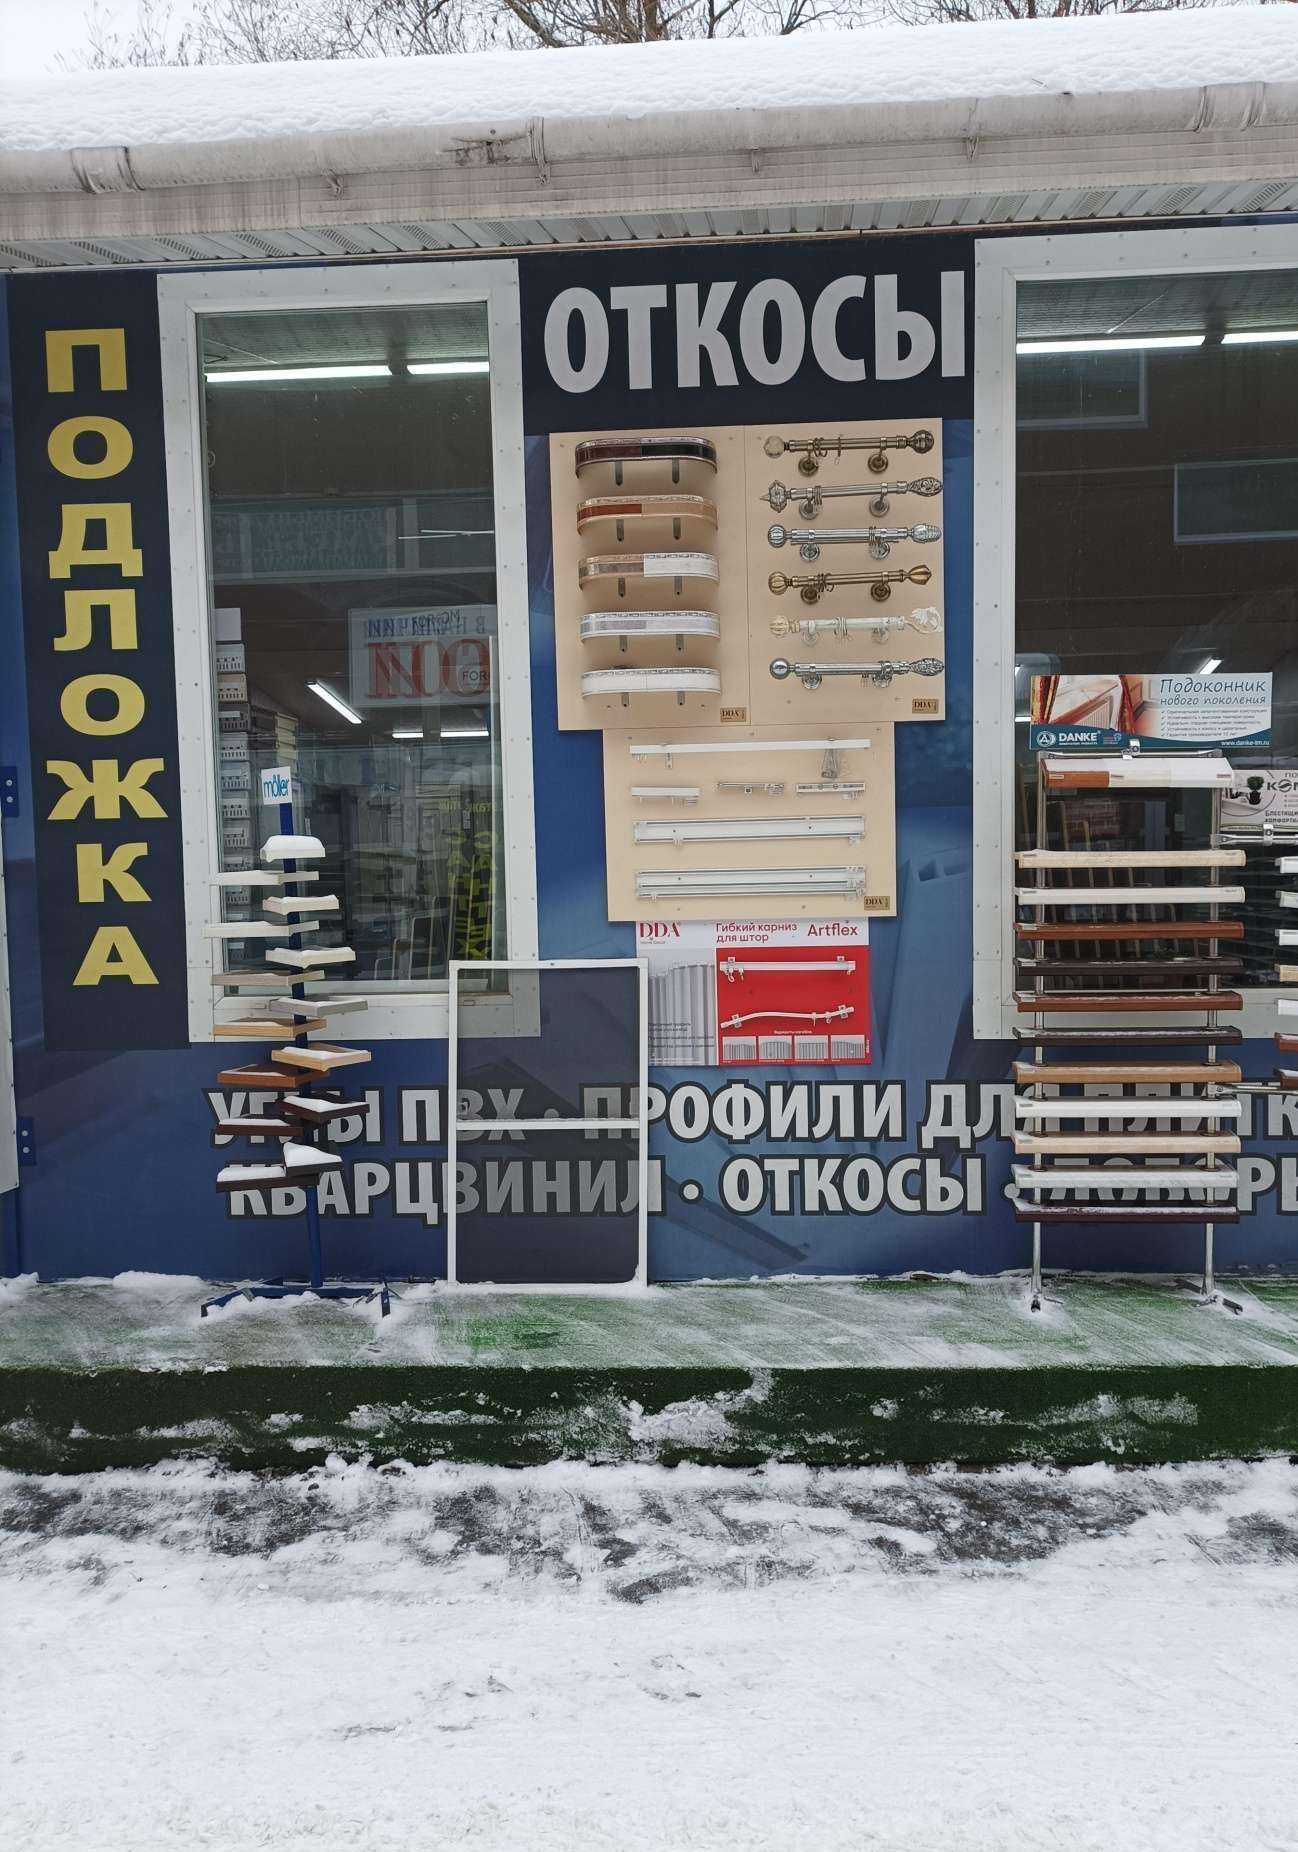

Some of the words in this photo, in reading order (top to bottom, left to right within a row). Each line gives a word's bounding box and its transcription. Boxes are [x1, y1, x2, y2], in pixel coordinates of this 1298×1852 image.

[544, 270, 965, 393] ОТКОСЫ
[45, 328, 168, 985] ПОДЛОЖКА
[1160, 677, 1267, 693] Подоконник
[1160, 694, 1199, 705] нового
[1204, 696, 1266, 705] поколения
[1058, 732, 1098, 742] DANKE
[639, 922, 680, 938] DDA
[716, 922, 756, 933] Гибкий
[758, 923, 798, 933] карниз
[807, 923, 858, 937] Artflex
[716, 933, 737, 943] для
[738, 934, 769, 943] штор
[401, 1088, 527, 1142] ПВХ
[583, 1083, 902, 1140] ПРОФИЛИ
[722, 1158, 982, 1213] ОТКОСЫ
